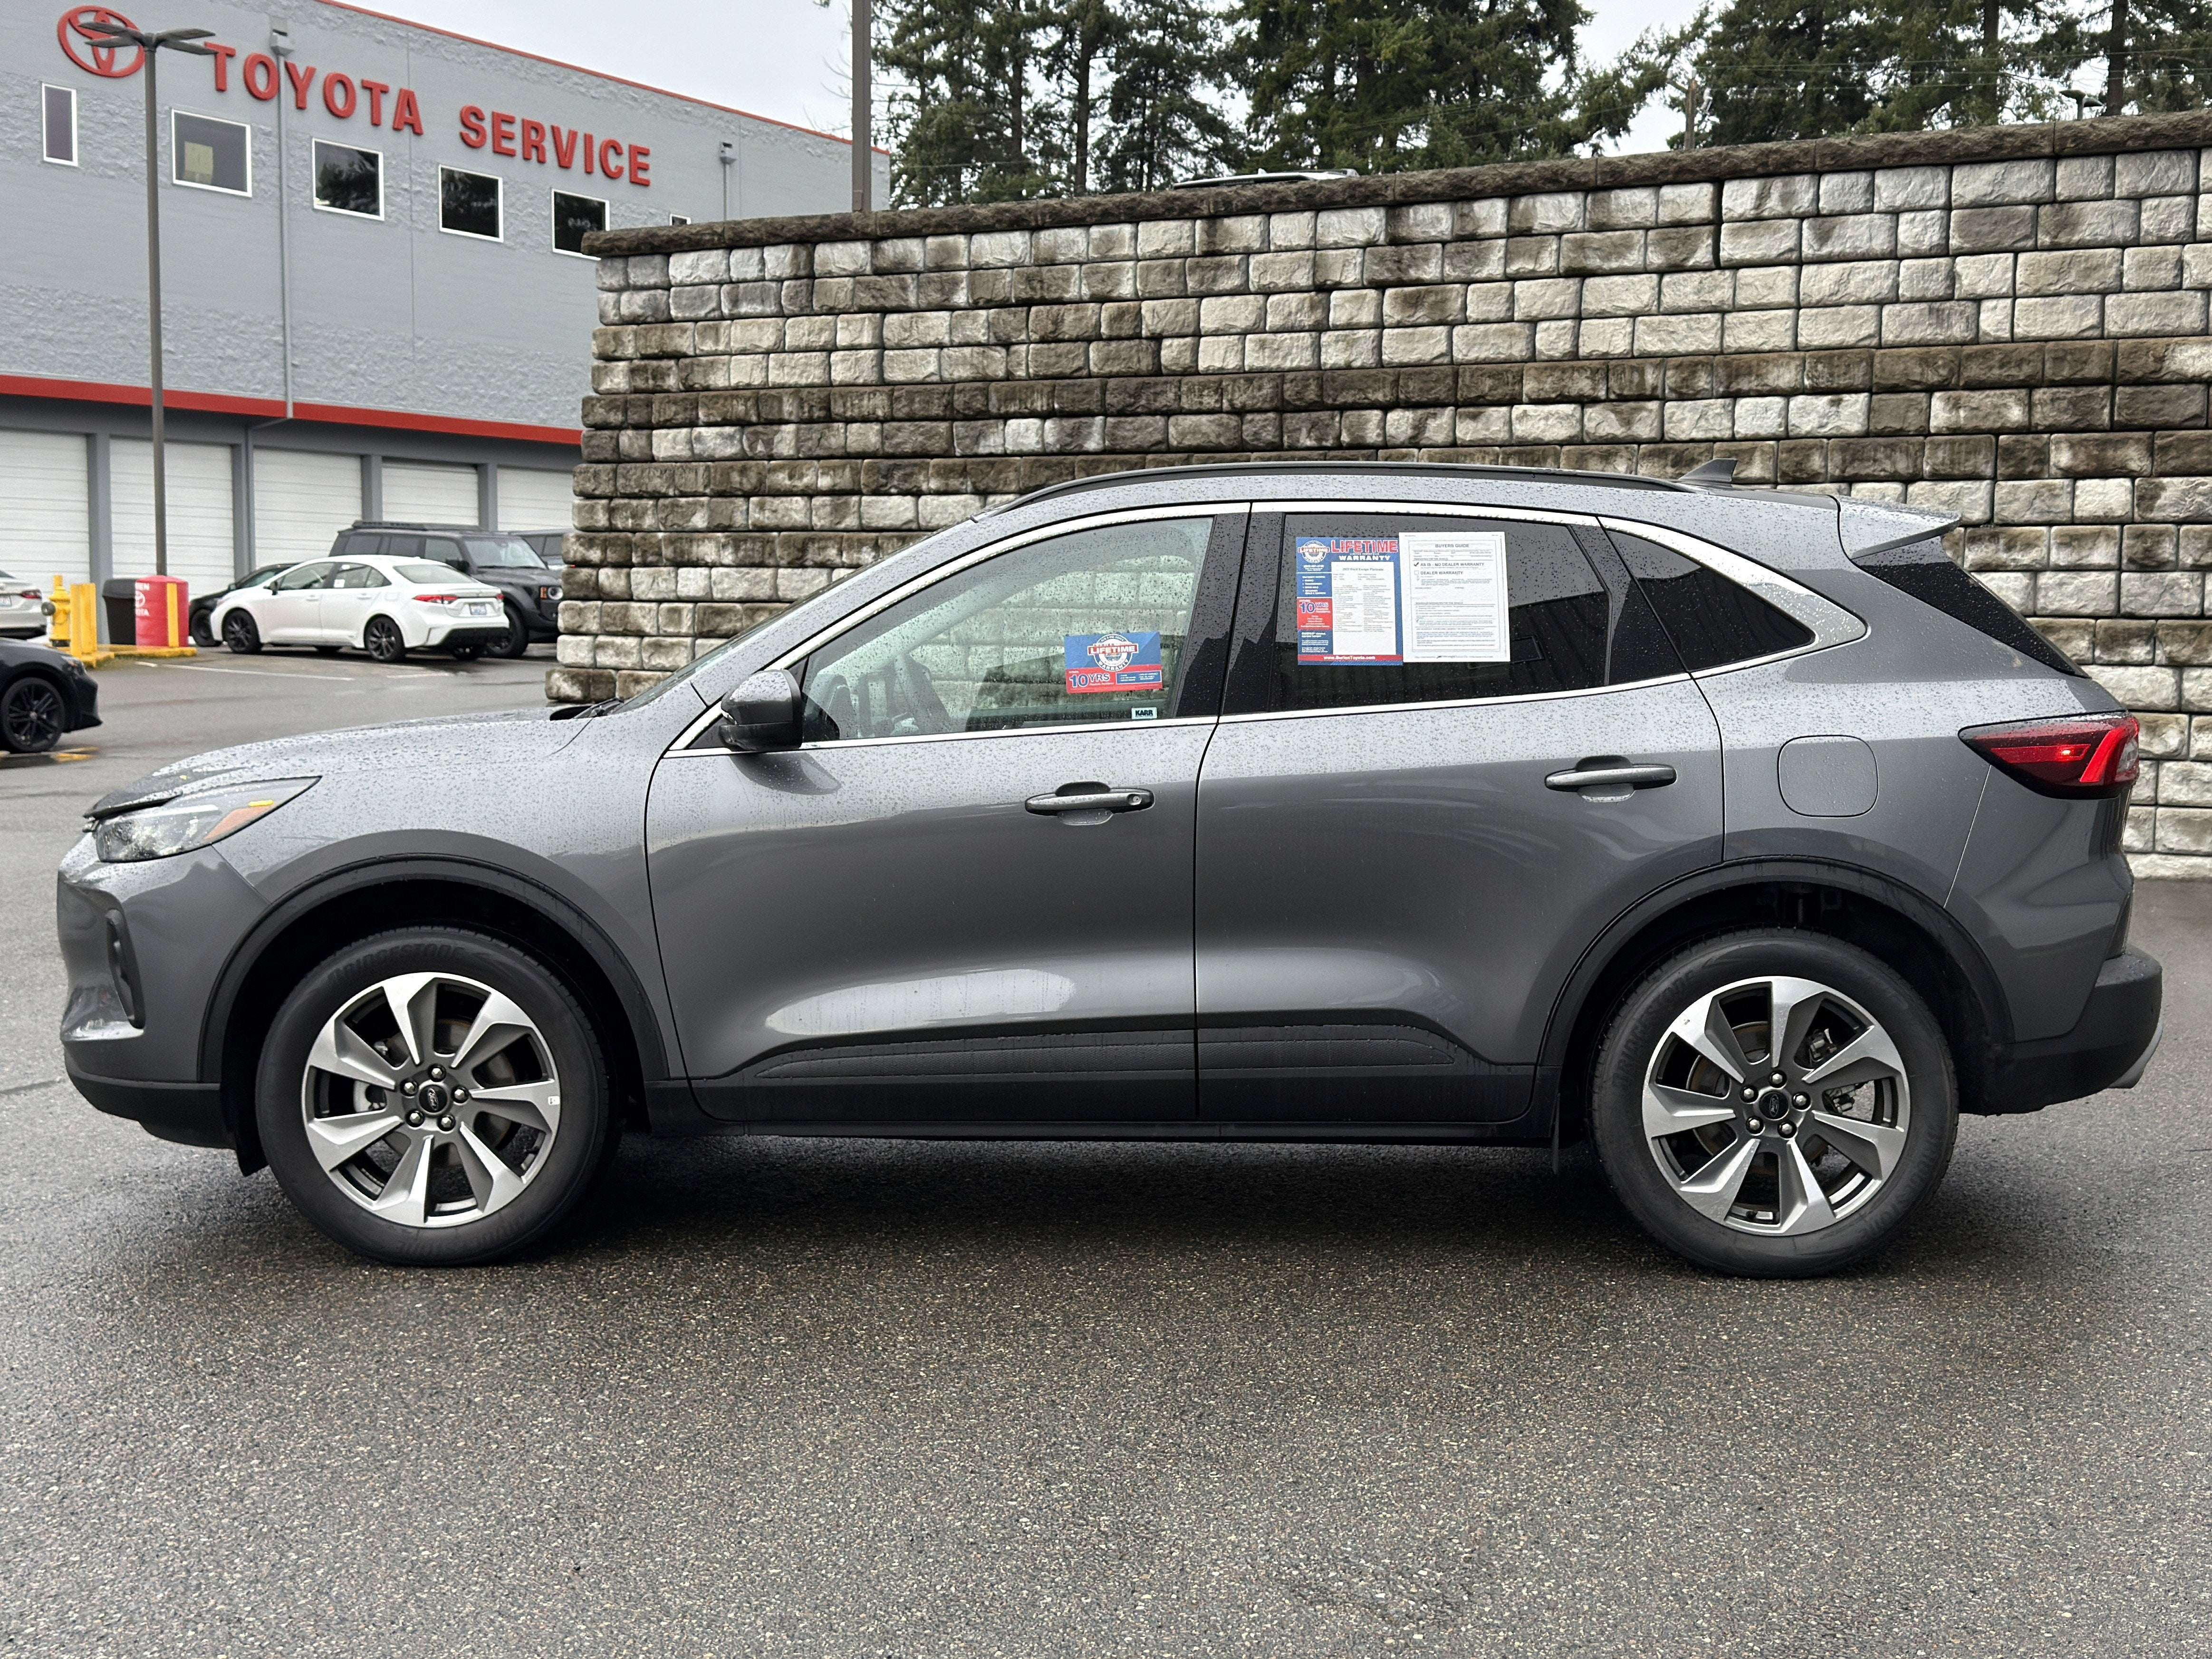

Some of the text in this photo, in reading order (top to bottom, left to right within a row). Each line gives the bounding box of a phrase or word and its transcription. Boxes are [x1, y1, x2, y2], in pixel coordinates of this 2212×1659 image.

[205, 42, 651, 187] TOYOTA SERVICE
[1331, 540, 1398, 553] LIFETIME
[1299, 602, 1316, 614] 10
[1090, 646, 1135, 654] LIFETIME
[1098, 658, 1129, 671] WARRANTY
[1069, 674, 1088, 688] 10
[1088, 673, 1110, 682] YRS
